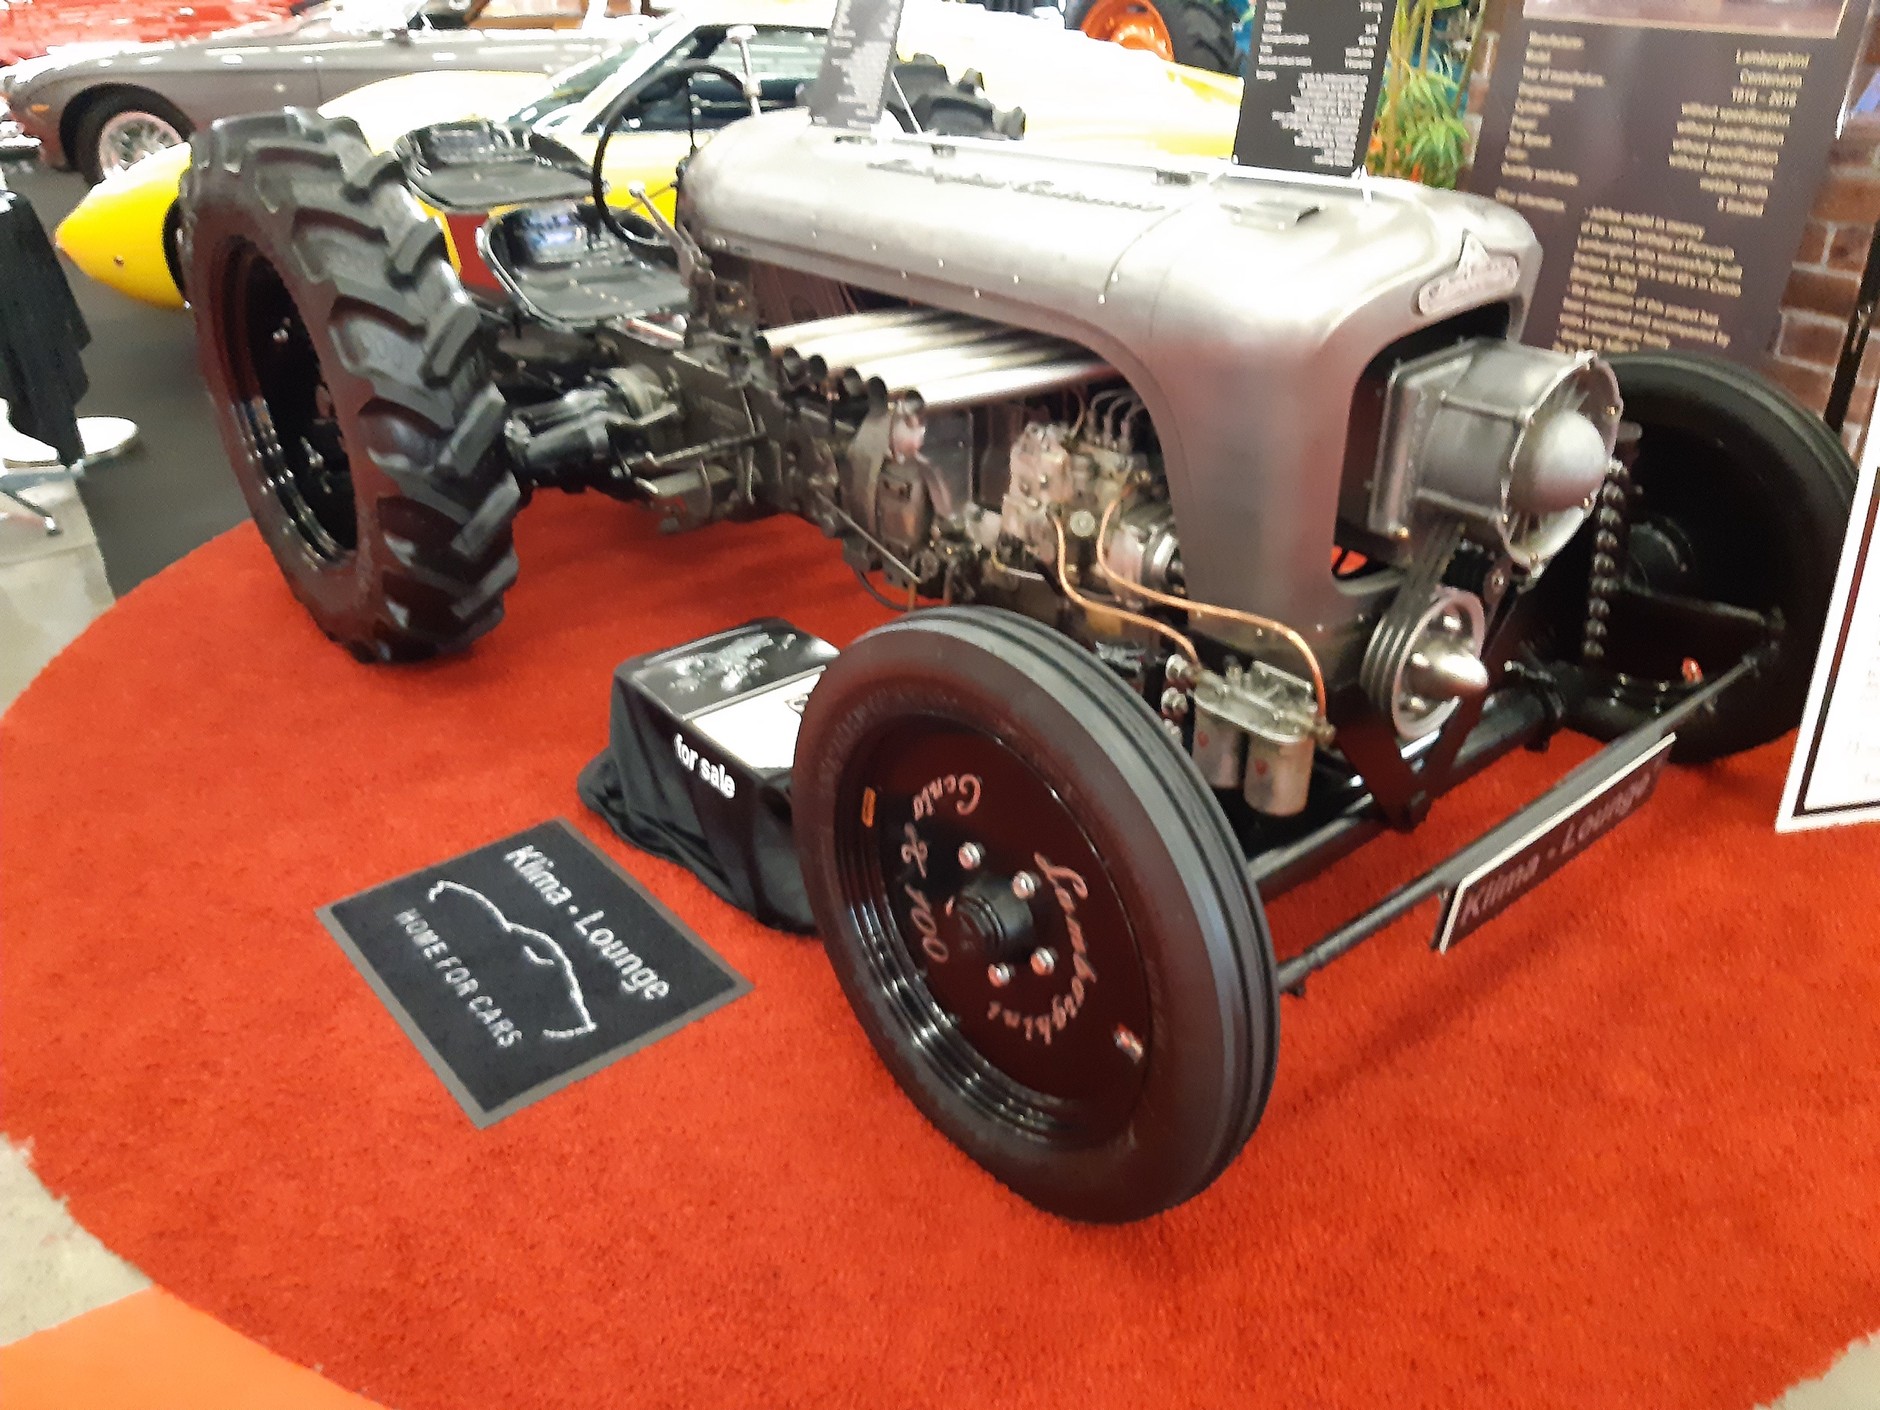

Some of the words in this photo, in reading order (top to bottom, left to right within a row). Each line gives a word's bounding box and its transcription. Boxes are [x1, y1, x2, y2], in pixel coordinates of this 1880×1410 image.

[674, 733, 698, 771] for
[700, 757, 736, 799] sale
[394, 907, 448, 960] HOME
[434, 953, 479, 998] FOR
[467, 994, 523, 1048] CARS
[504, 844, 572, 906] Klima
[573, 910, 671, 1001] Lounge
